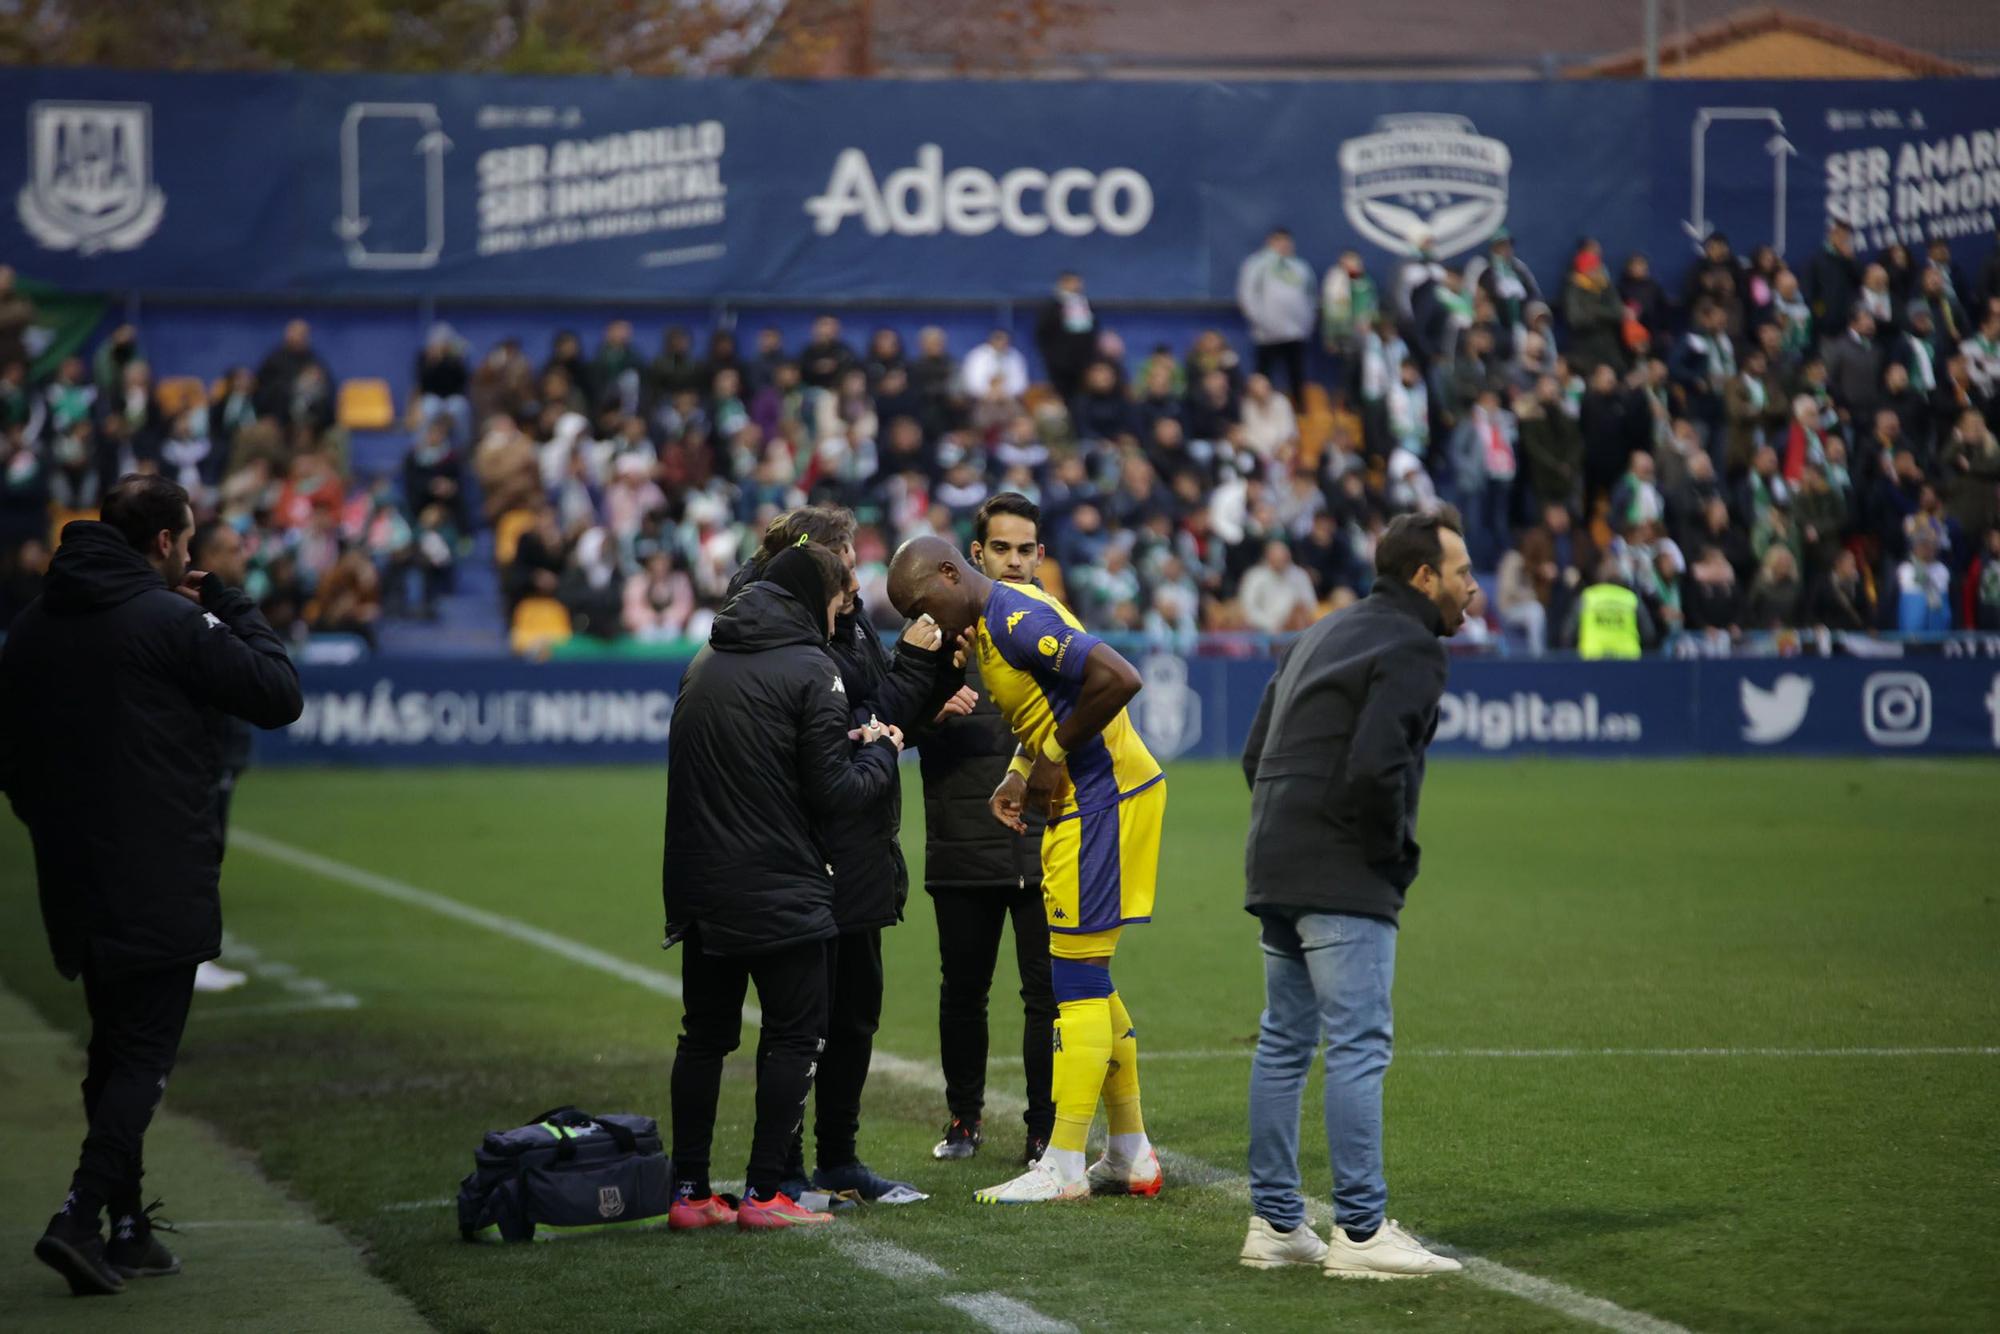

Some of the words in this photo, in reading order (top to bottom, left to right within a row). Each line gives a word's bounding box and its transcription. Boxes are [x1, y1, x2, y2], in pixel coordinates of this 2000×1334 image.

[478, 145, 549, 190] SER
[551, 120, 725, 178] AMARILLO
[805, 144, 1154, 236] Adecco
[1824, 146, 1891, 192] SER
[478, 184, 549, 231] SER
[551, 158, 727, 217] INMORTAL
[1824, 186, 1891, 230] SER
